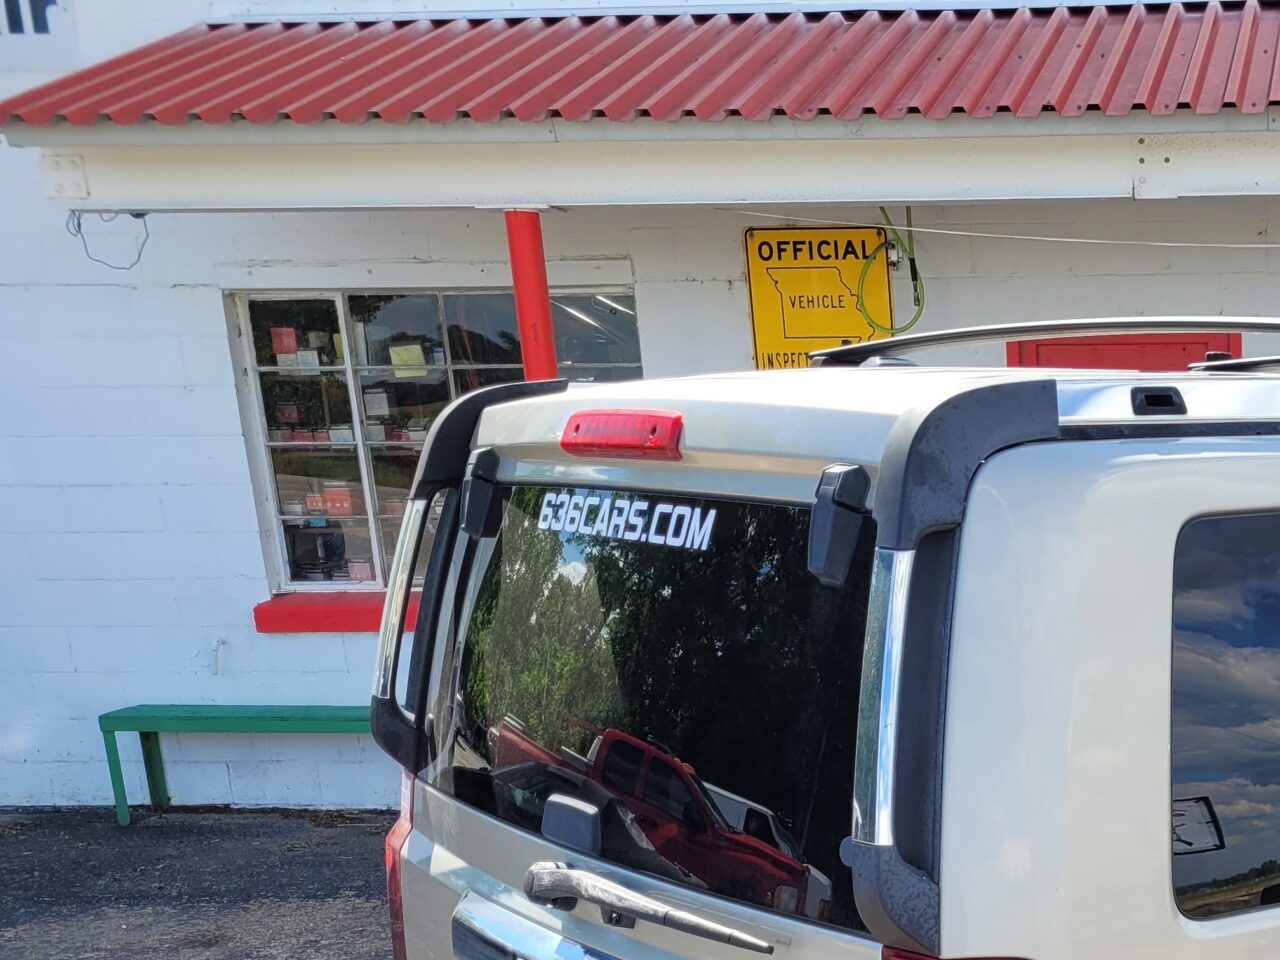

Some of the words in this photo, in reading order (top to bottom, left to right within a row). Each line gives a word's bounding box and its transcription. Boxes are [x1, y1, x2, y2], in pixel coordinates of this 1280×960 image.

[757, 240, 876, 261] OFFICIAL
[789, 294, 846, 309] VEHICLE
[761, 352, 812, 369] INSPECT
[538, 493, 717, 551] 636CARS.COM
